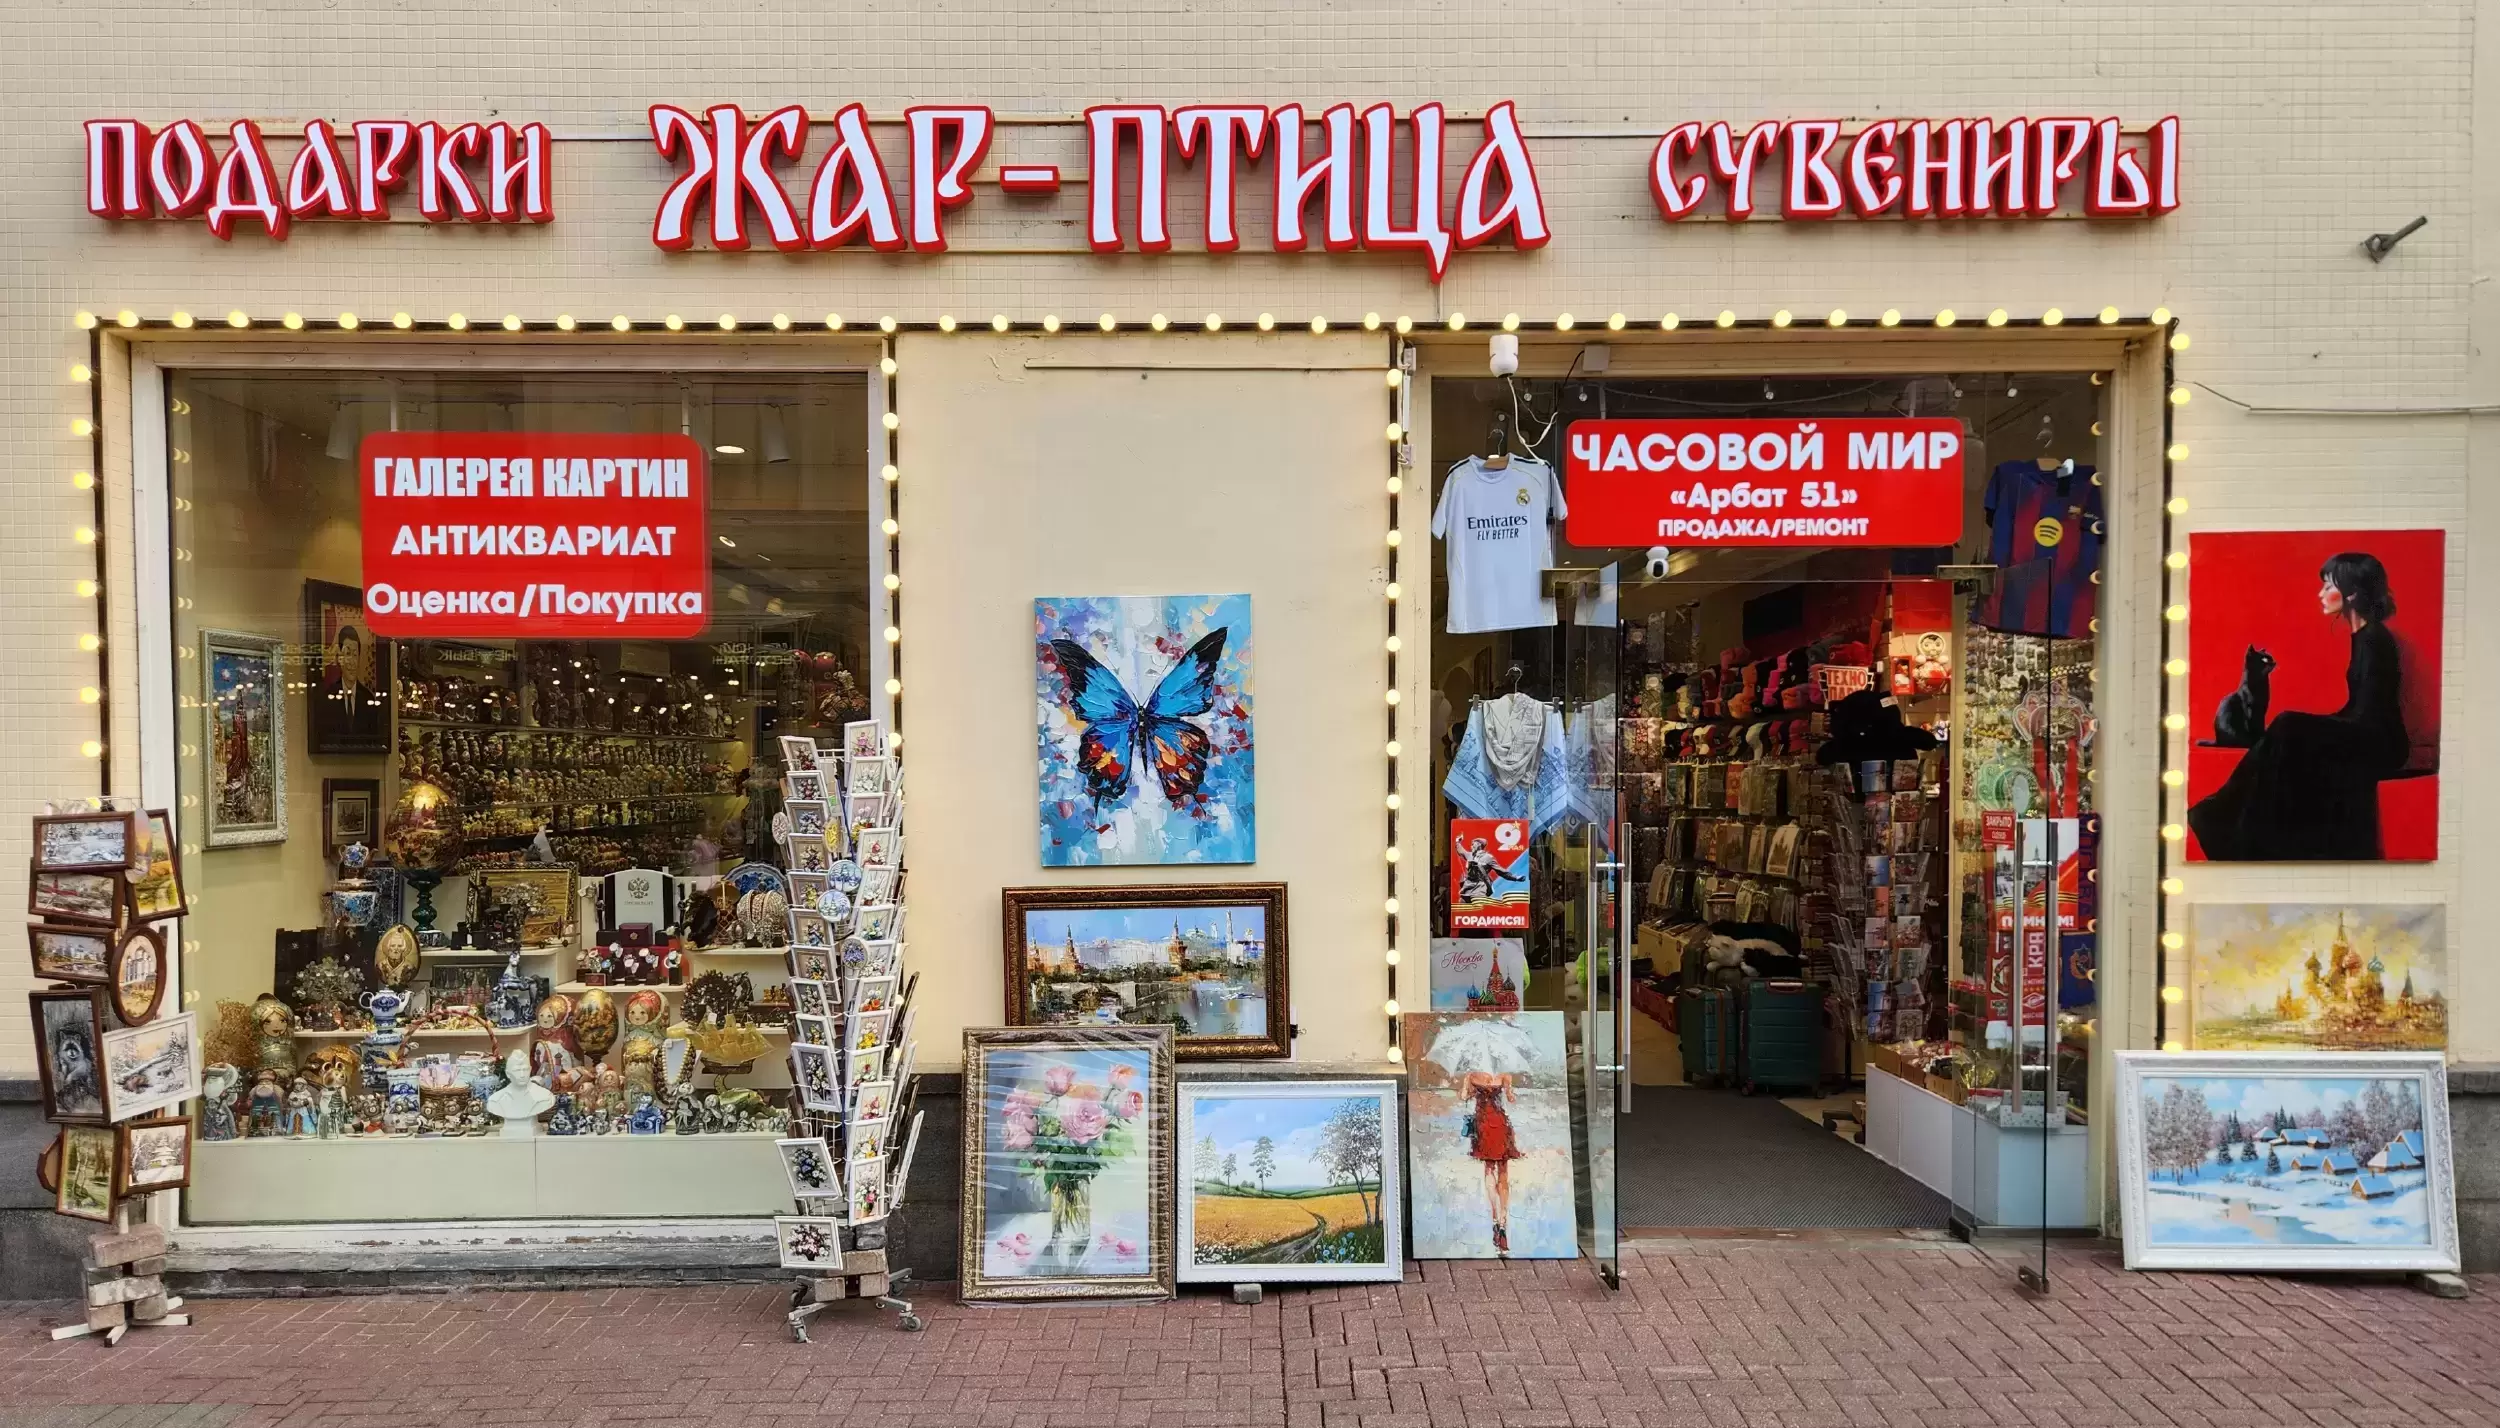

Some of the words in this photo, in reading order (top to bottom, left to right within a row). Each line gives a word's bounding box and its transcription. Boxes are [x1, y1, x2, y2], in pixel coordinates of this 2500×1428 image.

[84, 117, 555, 242] ПОДАРКИ
[1649, 115, 2180, 222] СУВЕНИРЫ
[648, 100, 1551, 285] ЖАР-ПТИЦА
[1572, 422, 1824, 472] ЧАСОВОЙ
[1848, 431, 1959, 470] МИР
[373, 457, 533, 497] ГАЛЕРЕЯ
[543, 458, 689, 498] КАРТИН
[1670, 481, 1788, 514] «Арбат
[1801, 481, 1859, 508] 51»
[1467, 514, 1528, 530] Emirates
[1477, 529, 1490, 541] FLY
[1492, 527, 1519, 541] BETTER
[1658, 517, 1869, 539] ПРОДАЖА/РЕМОНТ
[391, 525, 677, 556] АНТИКВАРИАТ
[366, 583, 702, 622] Оценка/Покупка
[1826, 669, 1867, 687] ТЕХНО
[1495, 823, 1521, 850] 9
[1455, 915, 1525, 927] ГОРДИМСЯ!
[1441, 951, 1484, 972] Москва
